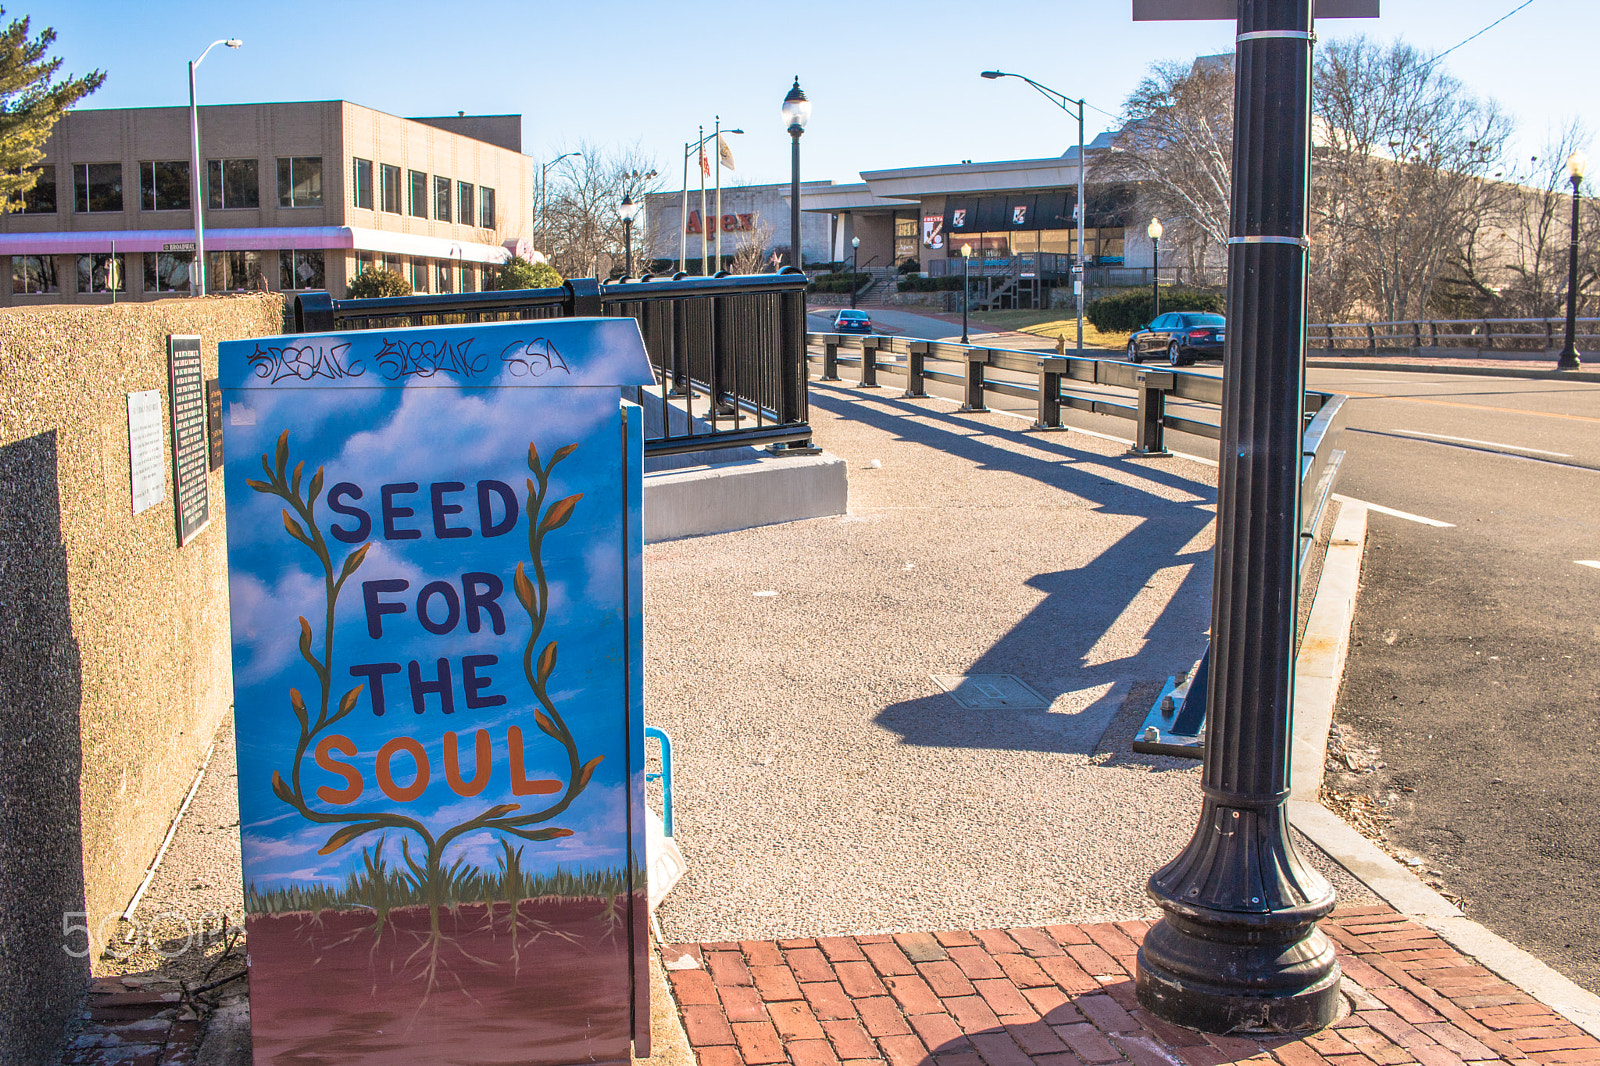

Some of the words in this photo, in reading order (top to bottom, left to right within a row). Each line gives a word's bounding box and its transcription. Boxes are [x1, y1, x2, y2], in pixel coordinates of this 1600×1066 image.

[686, 210, 754, 241] Apex
[327, 479, 519, 544] SEED
[362, 571, 506, 640] FOR
[349, 654, 507, 717] THE
[314, 725, 563, 805] SOUL
